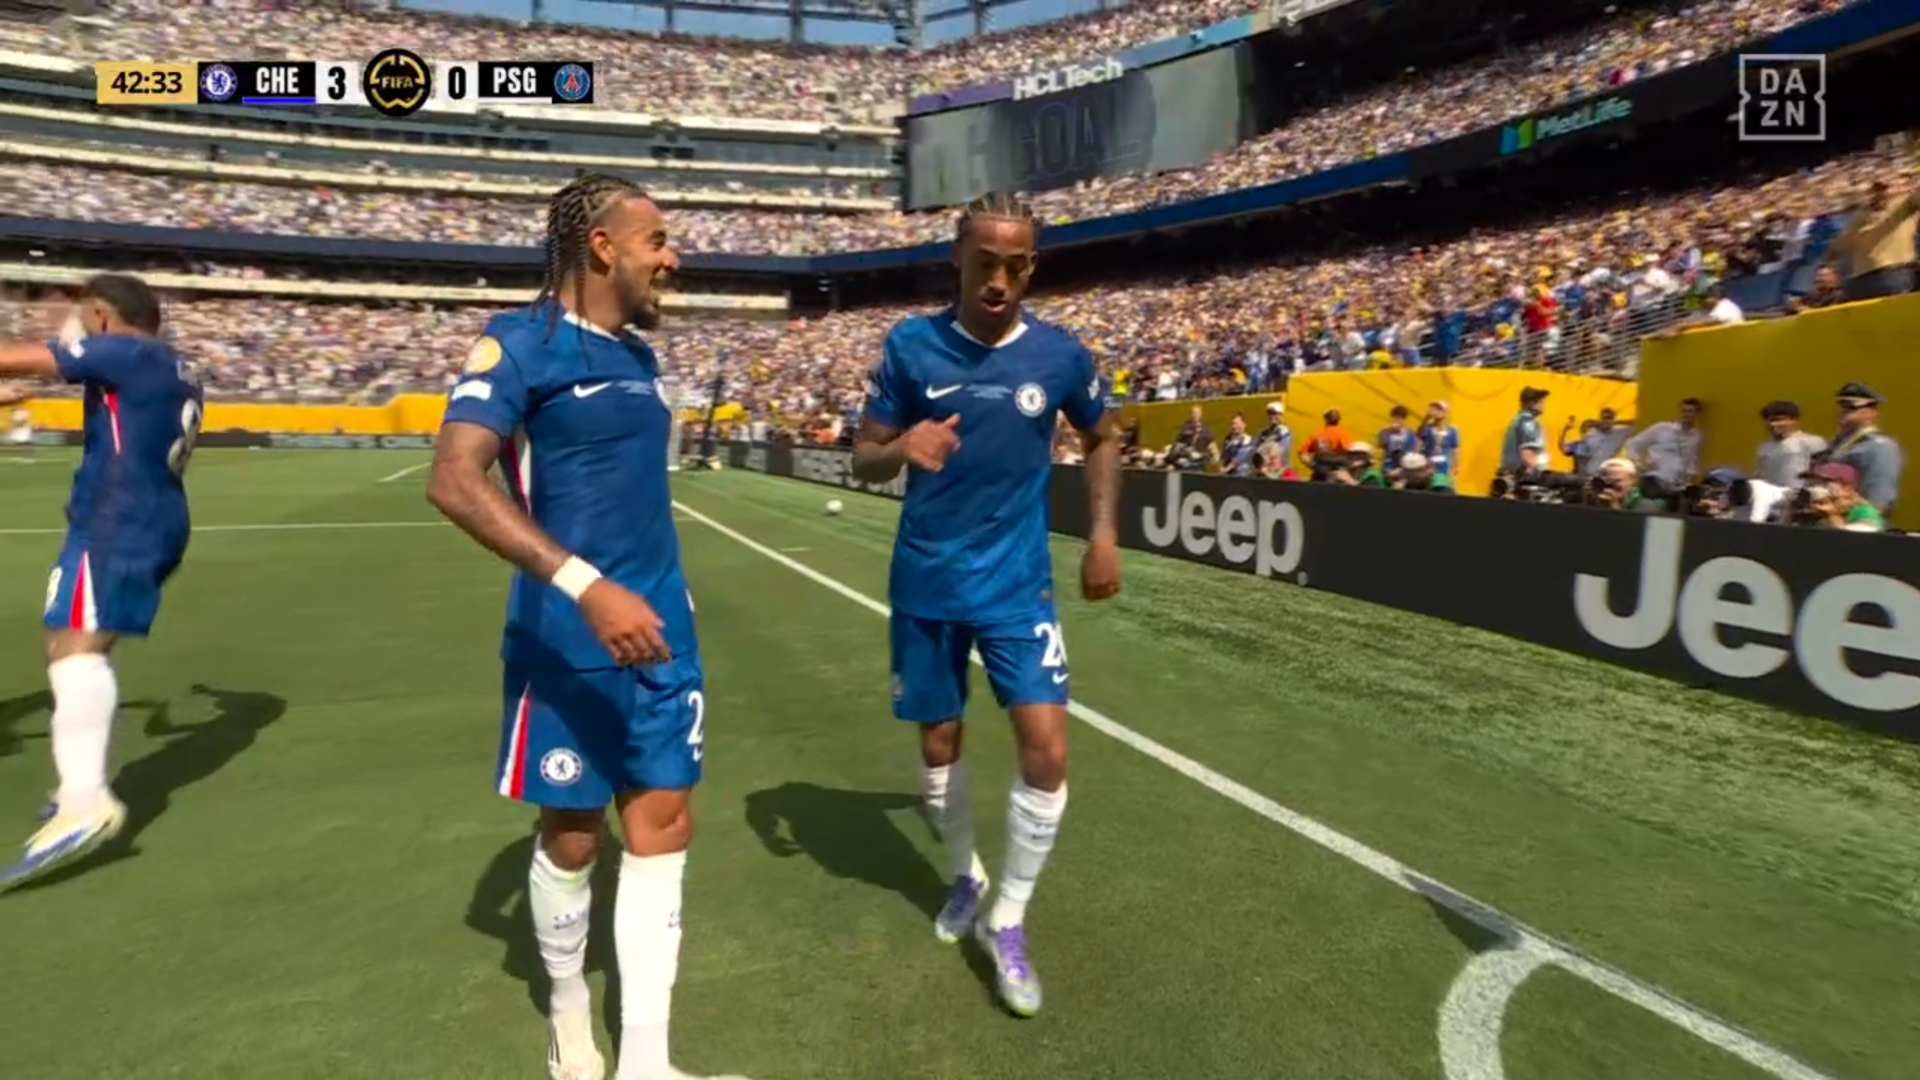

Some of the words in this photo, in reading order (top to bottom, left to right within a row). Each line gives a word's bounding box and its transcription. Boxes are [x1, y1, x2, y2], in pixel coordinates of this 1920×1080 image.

[1013, 58, 1123, 100] HCLTech
[1536, 96, 1633, 140] MetLife
[1142, 472, 1303, 576] Jeep
[1573, 517, 1920, 712] Jee
